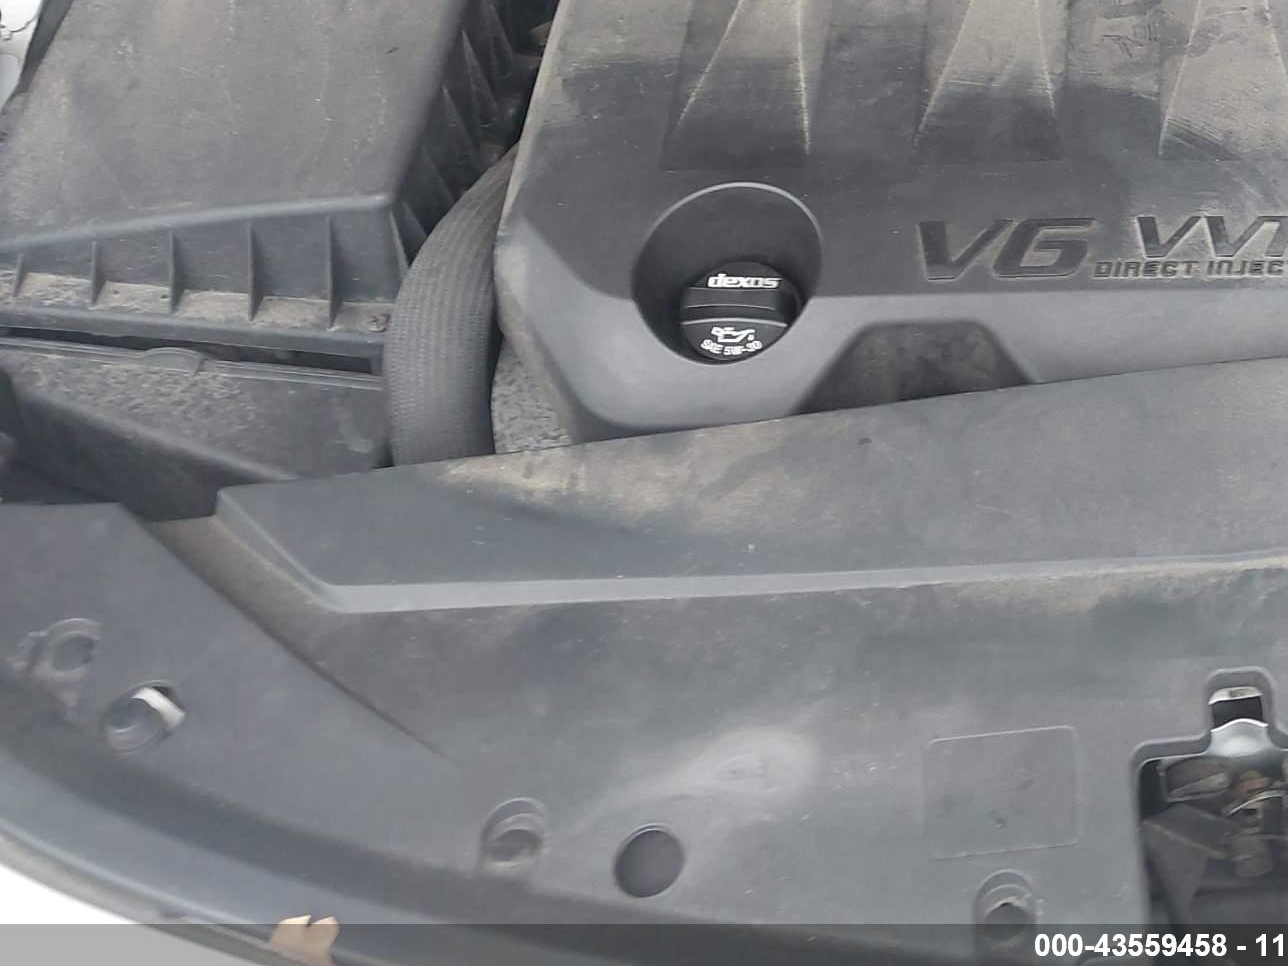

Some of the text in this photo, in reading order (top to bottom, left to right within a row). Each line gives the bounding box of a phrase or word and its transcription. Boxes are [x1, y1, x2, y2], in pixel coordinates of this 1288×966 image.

[917, 217, 1096, 281] V6
[1094, 260, 1197, 278] DIRECT
[707, 273, 783, 289] dexos
[701, 339, 723, 355] SAE
